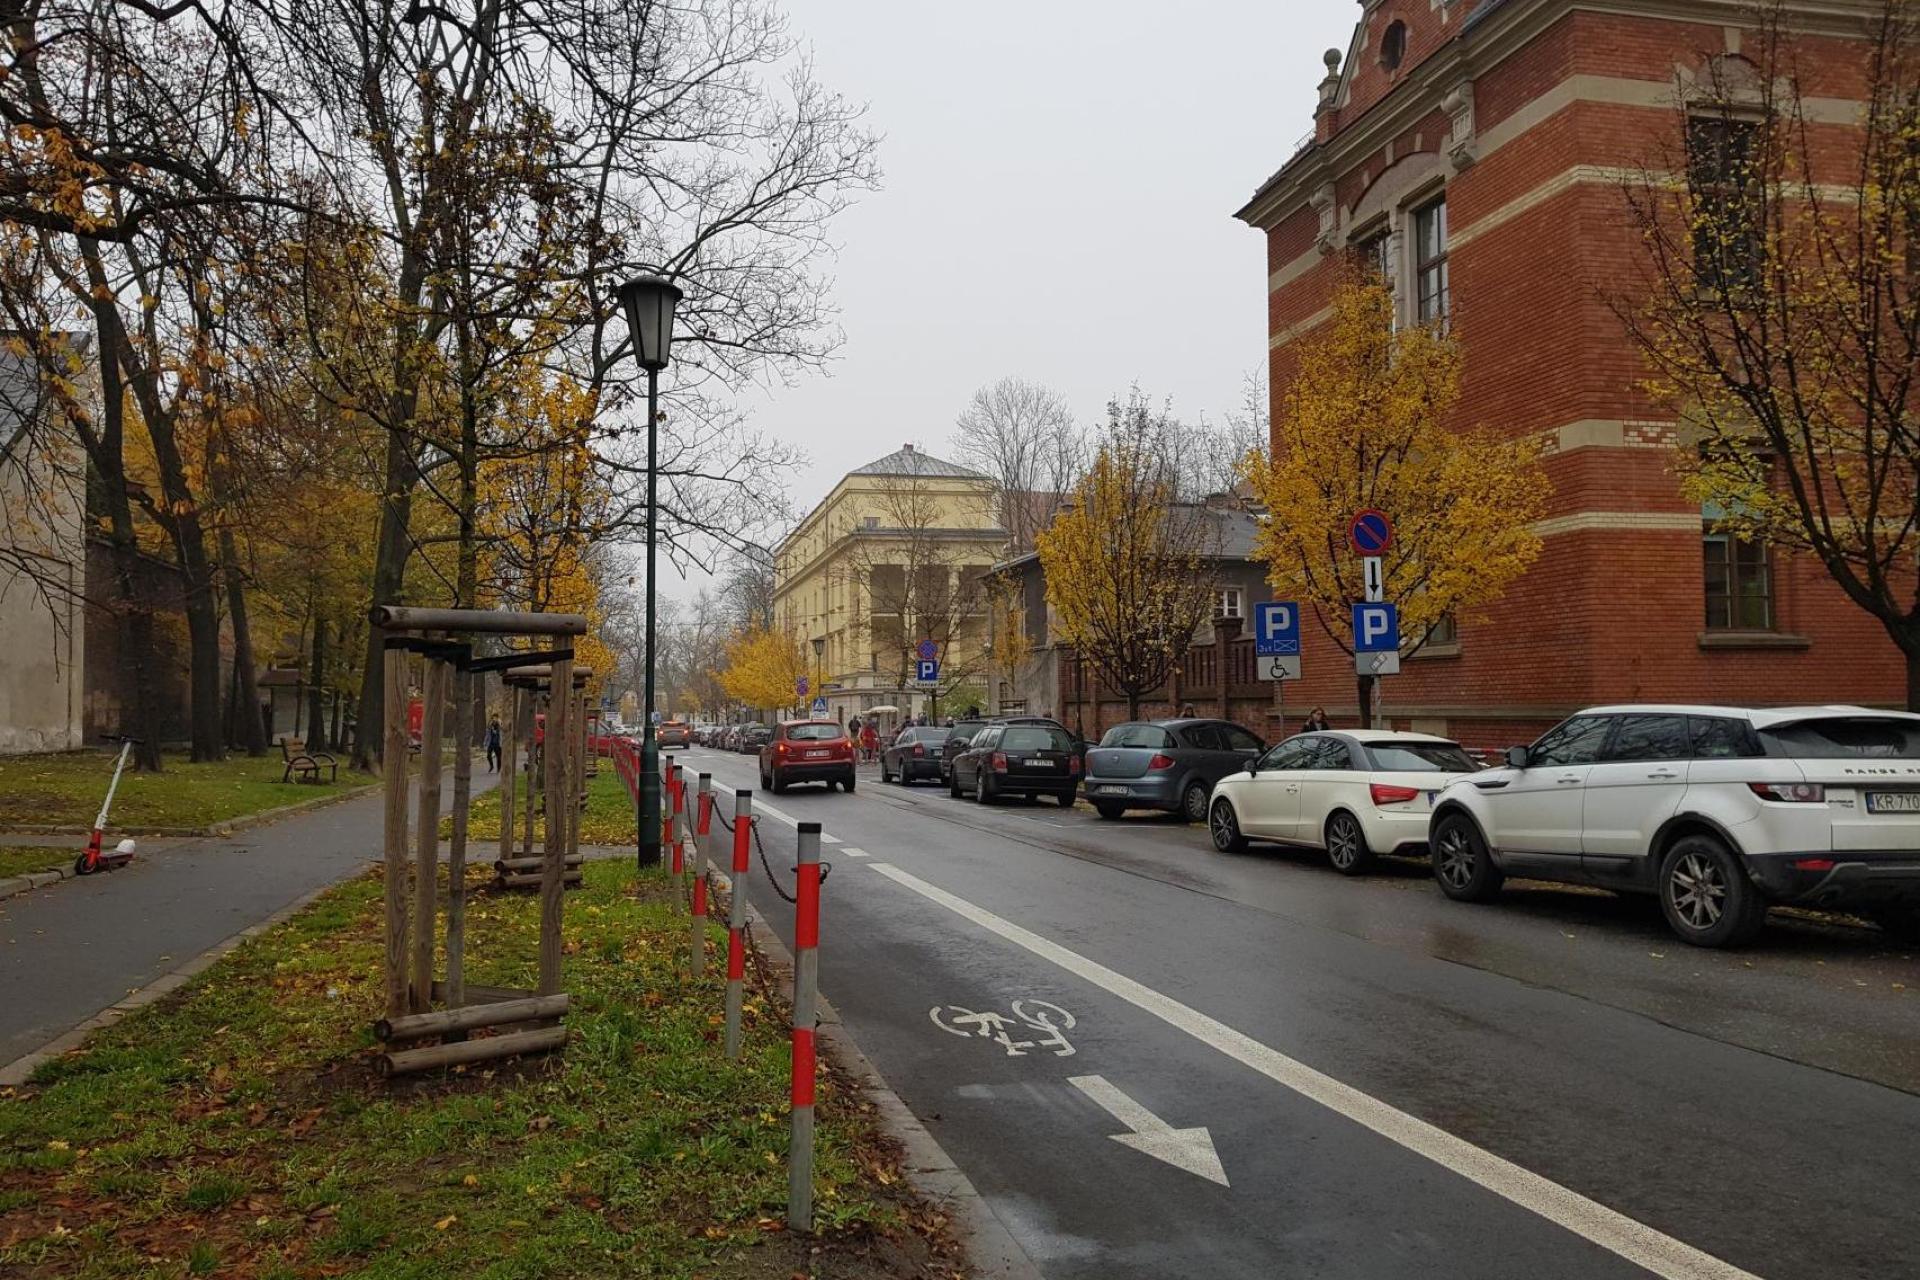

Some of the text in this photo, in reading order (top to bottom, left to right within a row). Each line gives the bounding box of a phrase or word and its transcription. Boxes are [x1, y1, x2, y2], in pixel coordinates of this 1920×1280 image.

[1265, 606, 1290, 639] P
[1363, 608, 1388, 645] P
[922, 662, 934, 678] P
